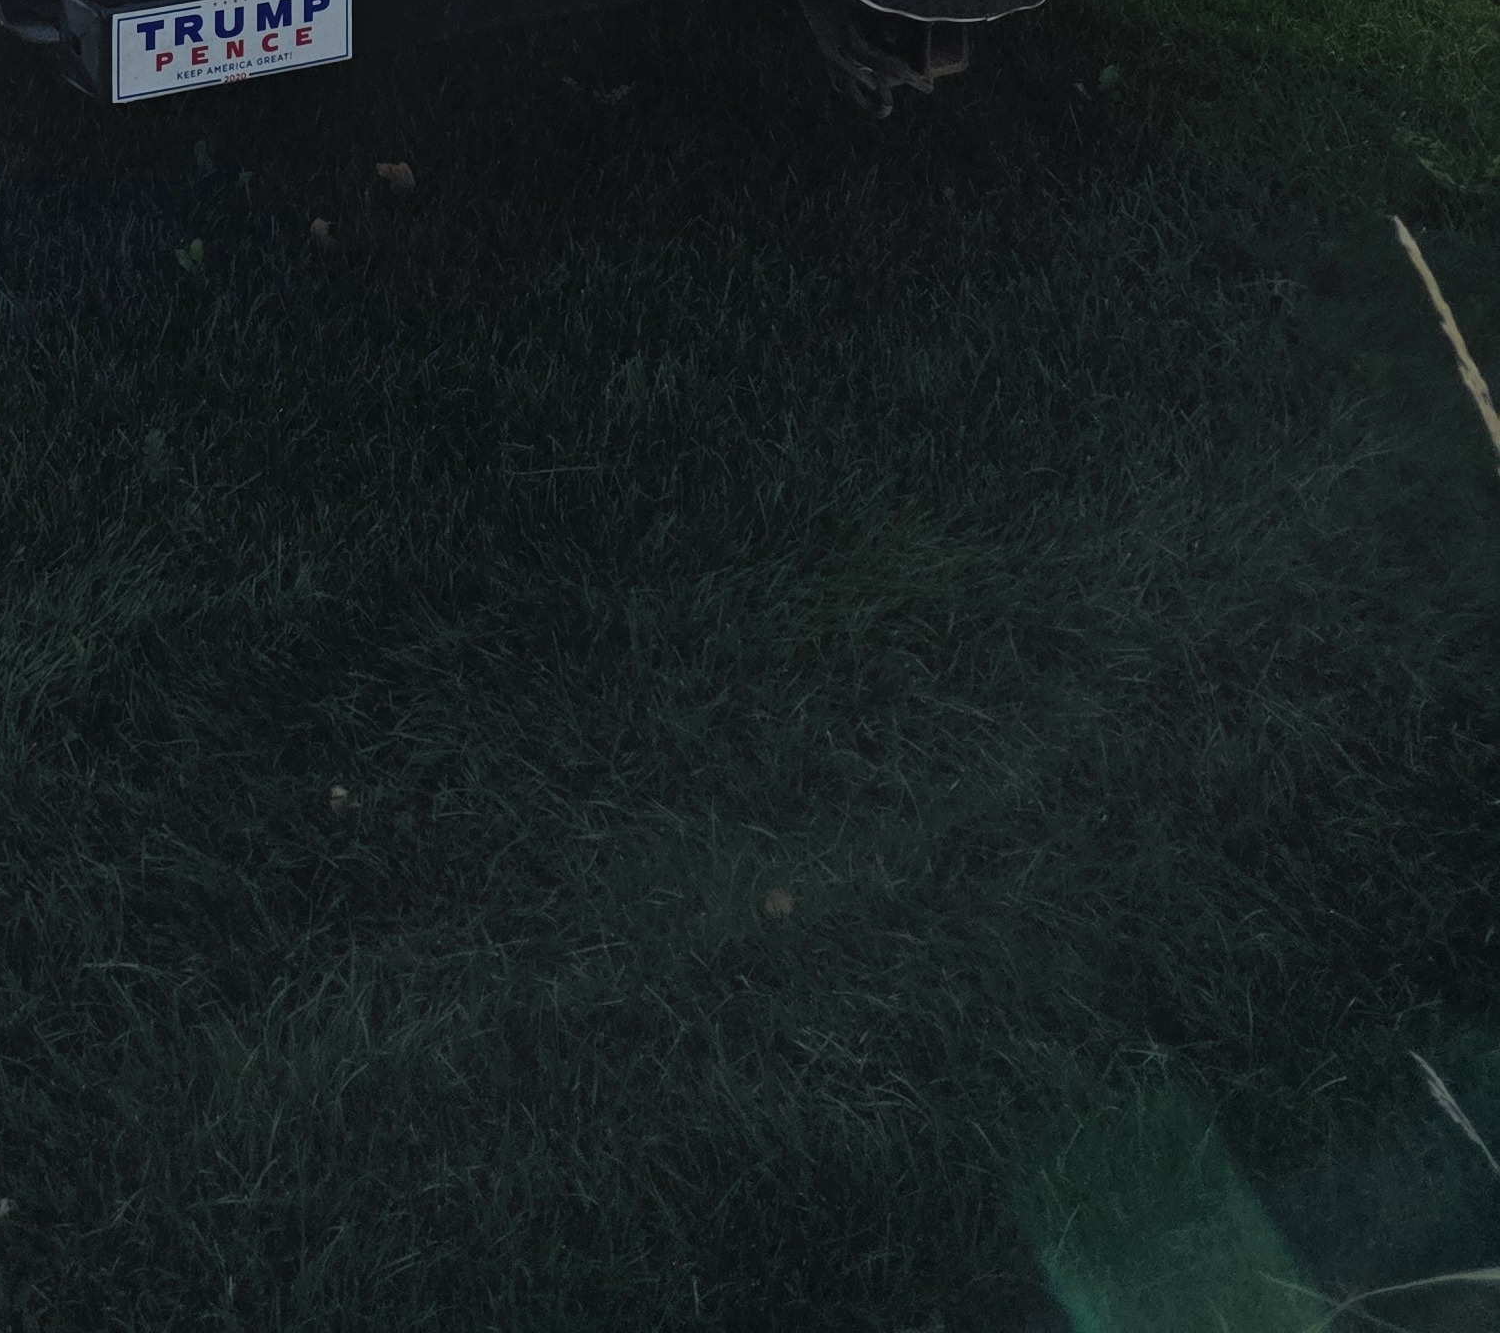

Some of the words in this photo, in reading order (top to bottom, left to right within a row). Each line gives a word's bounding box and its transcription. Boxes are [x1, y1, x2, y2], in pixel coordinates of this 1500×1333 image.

[156, 27, 313, 72] PENCE
[176, 69, 203, 81] KEEP
[206, 60, 253, 75] AMERICA
[257, 51, 293, 66] GREAT!
[223, 73, 247, 84] 2020
